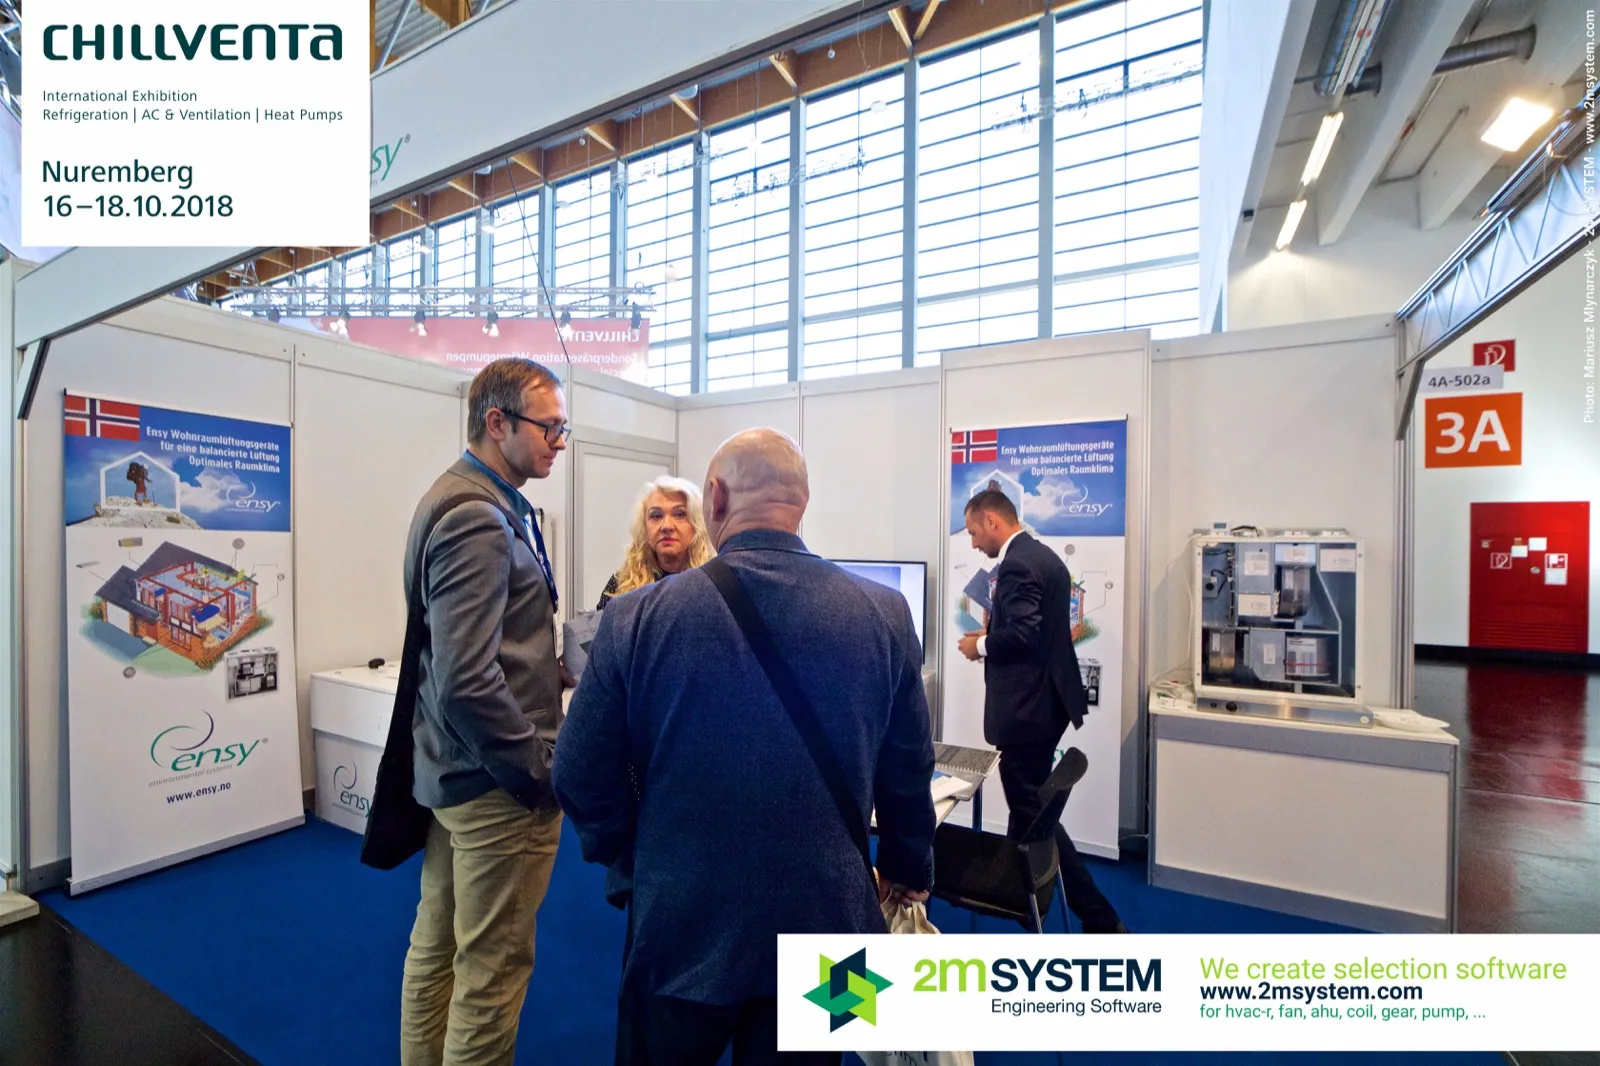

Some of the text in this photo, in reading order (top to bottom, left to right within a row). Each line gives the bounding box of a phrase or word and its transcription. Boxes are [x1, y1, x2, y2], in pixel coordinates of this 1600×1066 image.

[1428, 374, 1491, 388] 4A-502a
[147, 427, 279, 451] Ensy Wohnraumlüftungsgeräte
[1435, 409, 1511, 455] 3A
[161, 441, 280, 463] für eine balancierte Lüftung
[1001, 441, 1114, 456] Ensy Wohnraumlüftungsgeräte
[188, 455, 280, 474] Optimales Raumklima
[1010, 452, 1114, 466] für eine balancierte Lüftung
[1031, 464, 1114, 476] Optimales Raumklima
[166, 782, 232, 804] www.ensy.no
